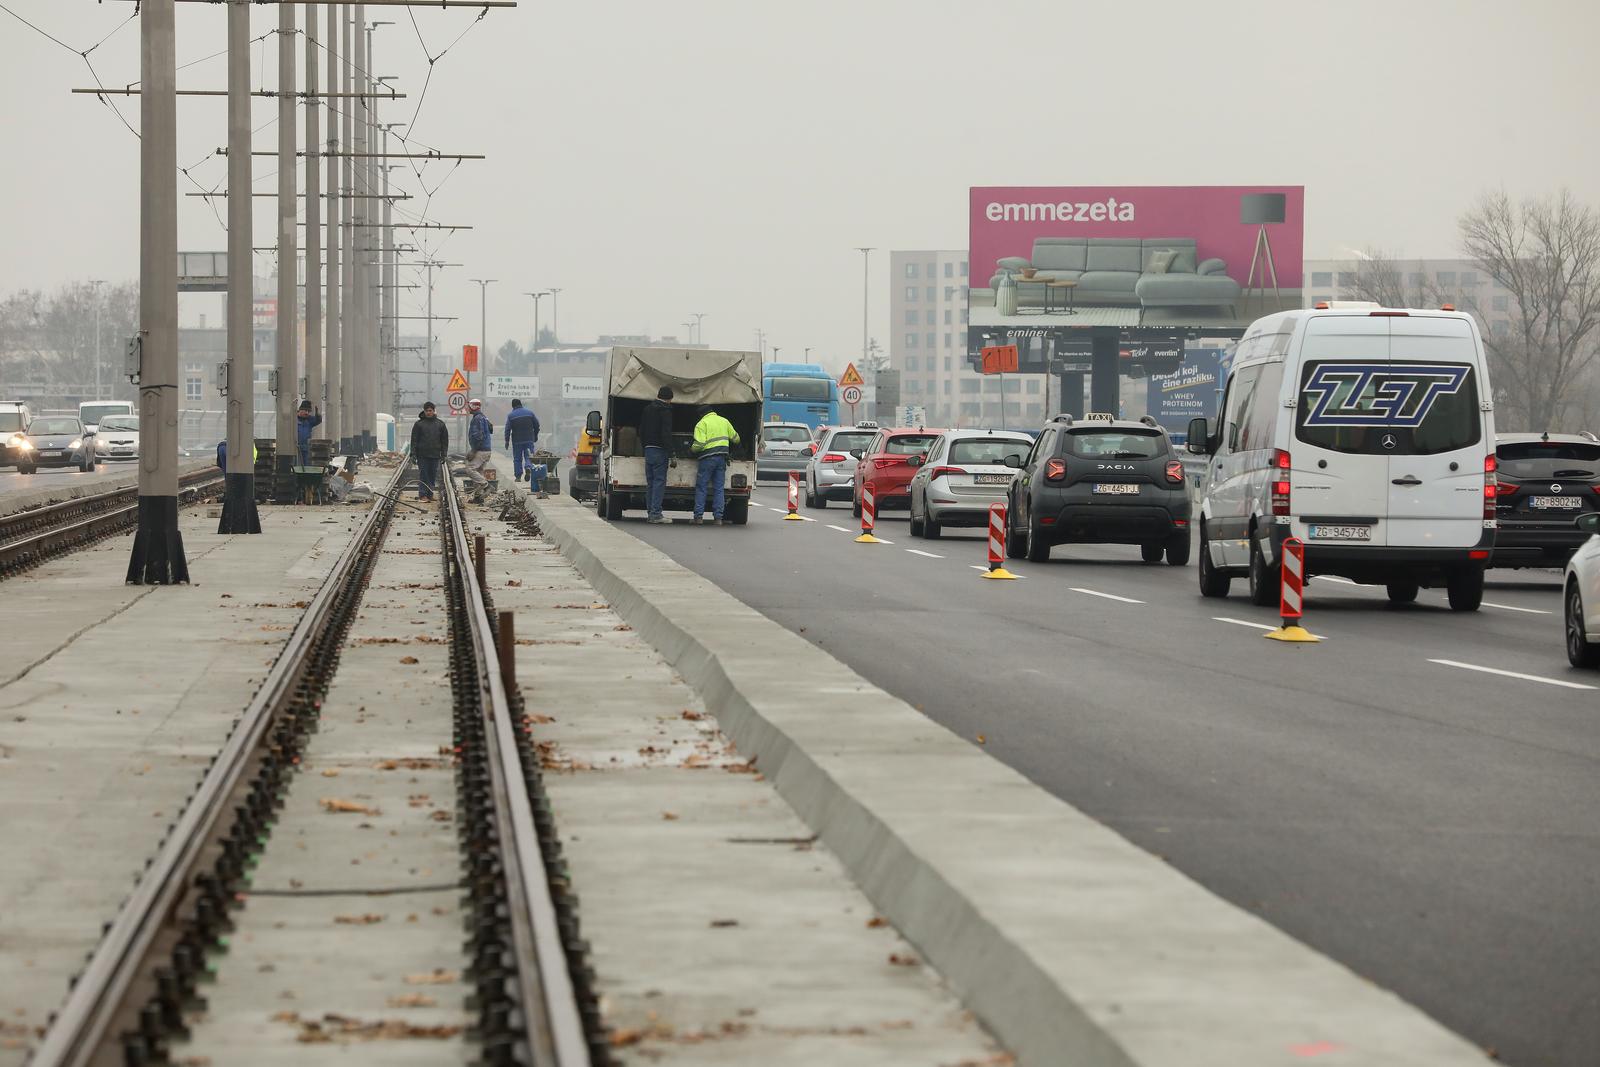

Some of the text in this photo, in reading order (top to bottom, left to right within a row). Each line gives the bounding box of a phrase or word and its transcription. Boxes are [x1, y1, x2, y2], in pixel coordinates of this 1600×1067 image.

[986, 197, 1135, 222] emmezeta
[1182, 365, 1198, 376] koji
[1162, 379, 1181, 388] čine
[846, 390, 858, 400] 40
[1303, 363, 1472, 428] ZET
[451, 397, 463, 406] 40
[1535, 497, 1545, 506] ZG
[1316, 527, 1370, 538] ZG 9457-GK
